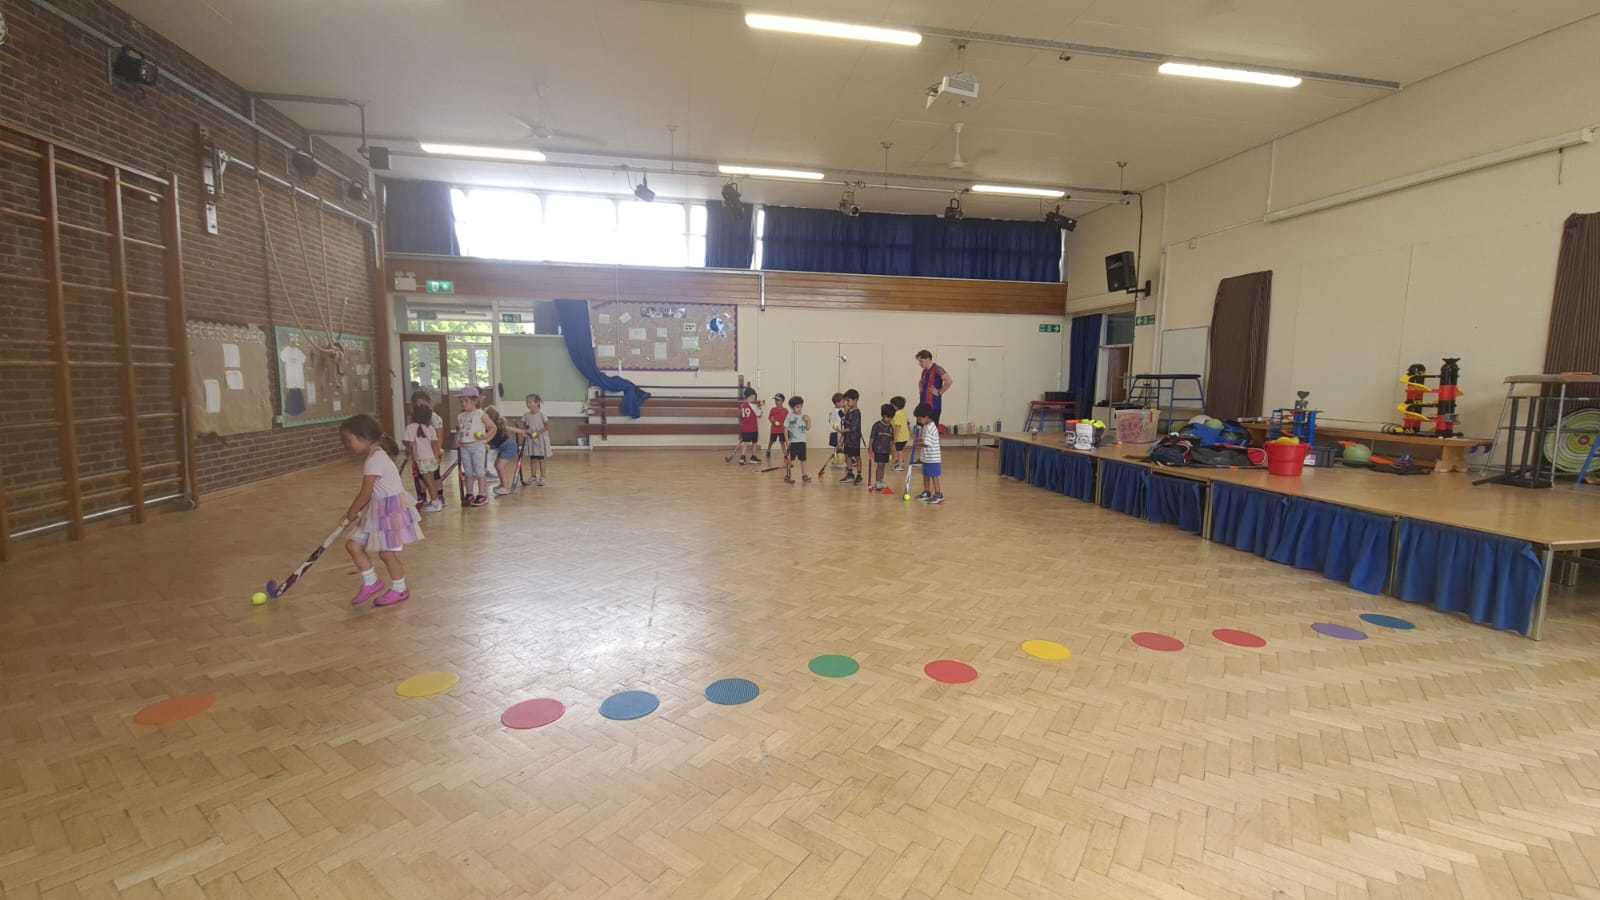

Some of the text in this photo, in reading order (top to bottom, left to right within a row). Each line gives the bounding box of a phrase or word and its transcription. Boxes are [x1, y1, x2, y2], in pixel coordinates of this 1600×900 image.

[185, 322, 228, 342] SPORTS
[288, 332, 299, 346] PE
[742, 407, 751, 418] 19
